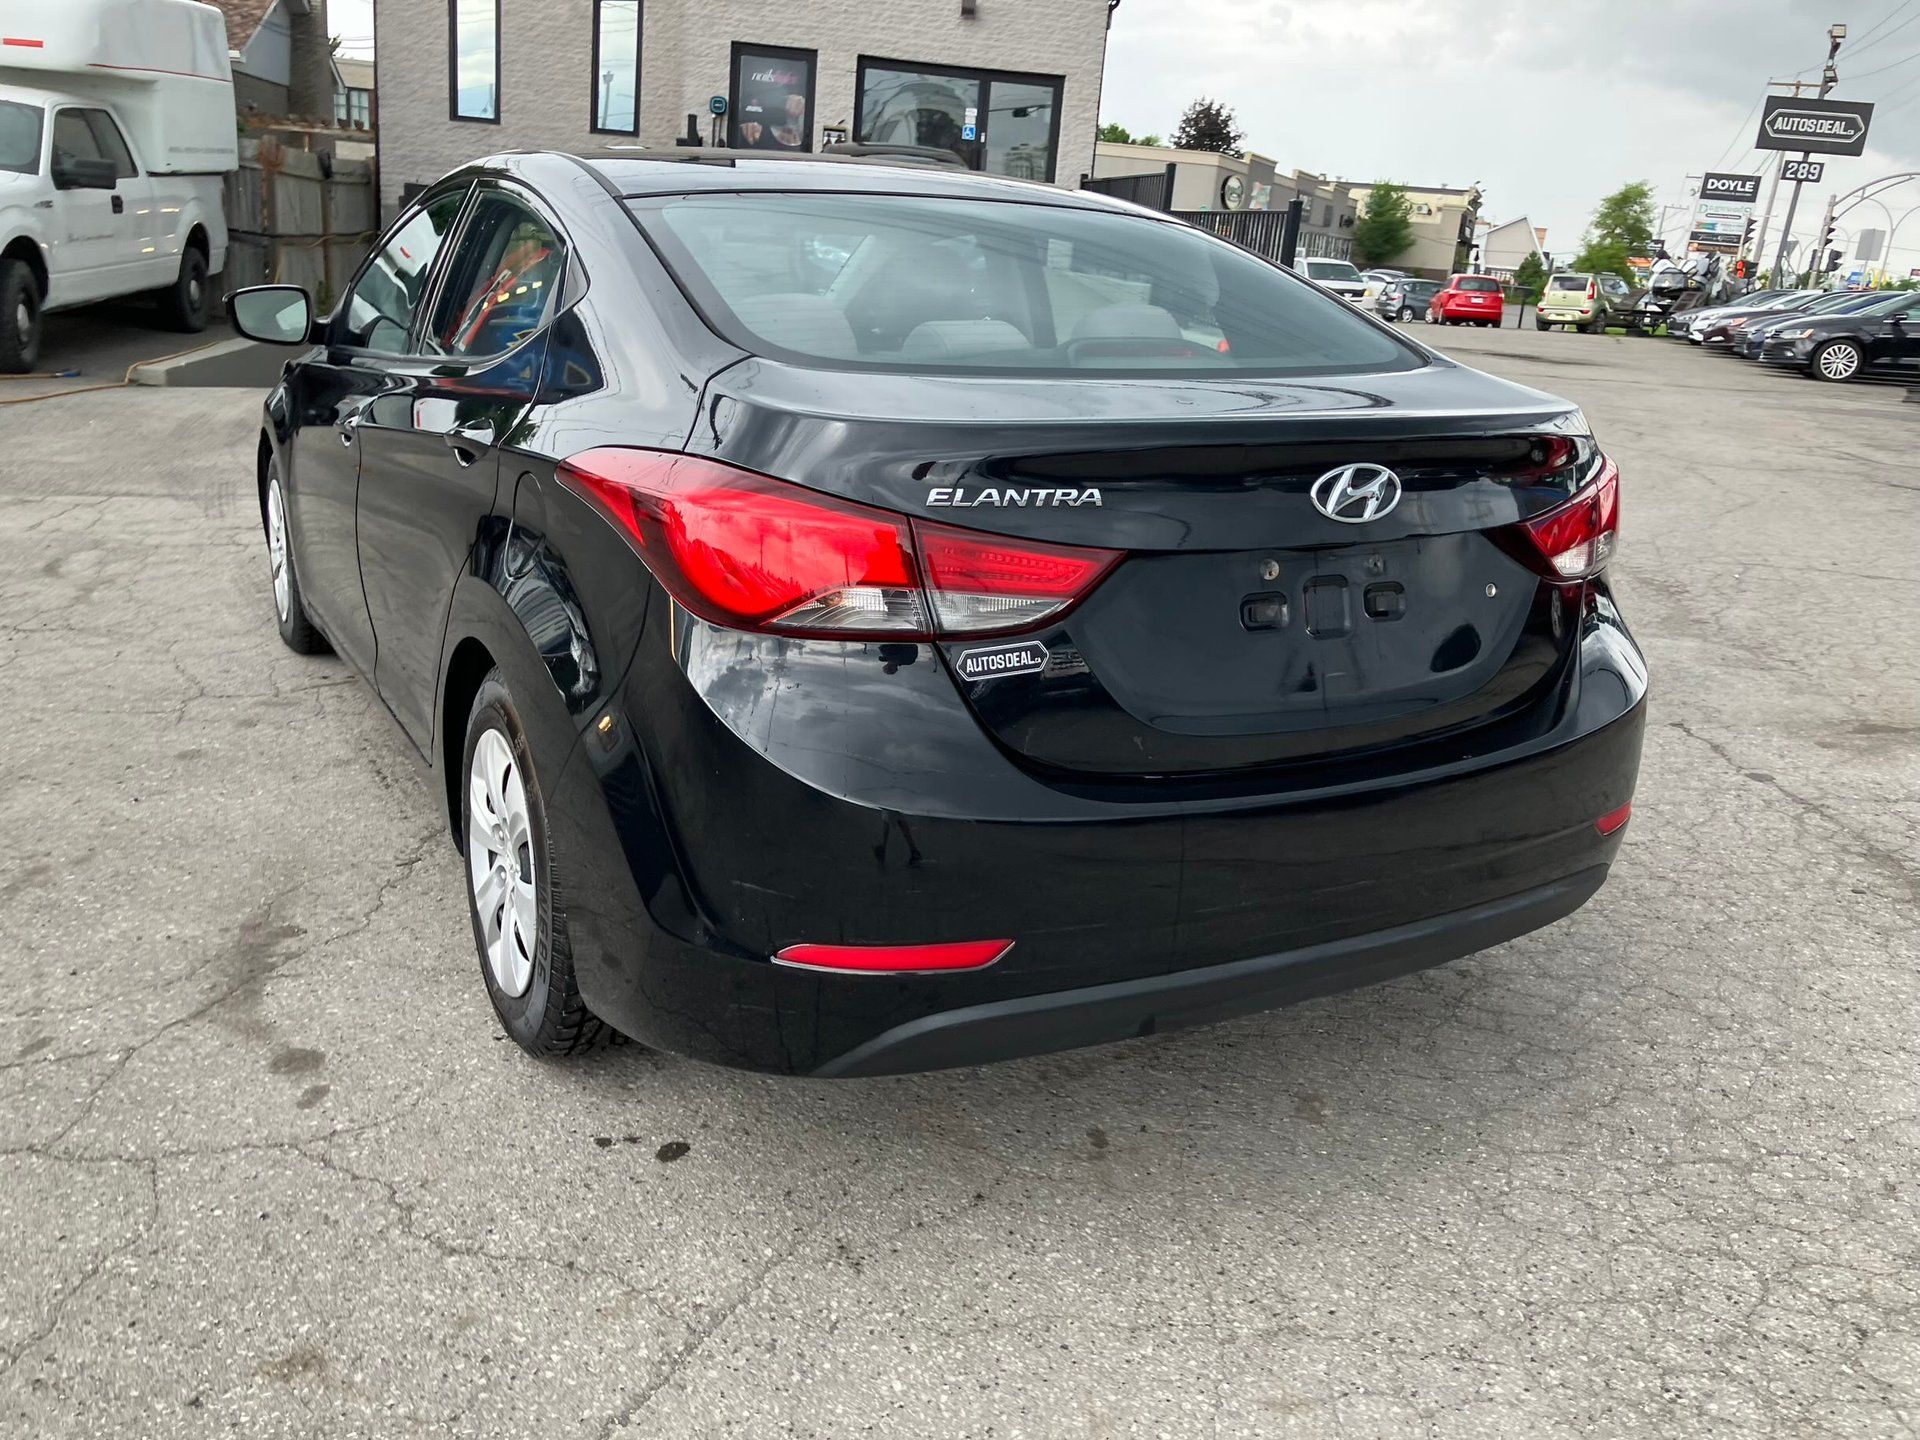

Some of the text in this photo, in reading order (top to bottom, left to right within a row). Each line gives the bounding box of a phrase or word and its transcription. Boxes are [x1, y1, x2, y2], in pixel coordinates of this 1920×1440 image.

[1785, 162, 1821, 180] 289
[1706, 178, 1755, 192] DOYLE
[926, 487, 1103, 508] ELANTRA
